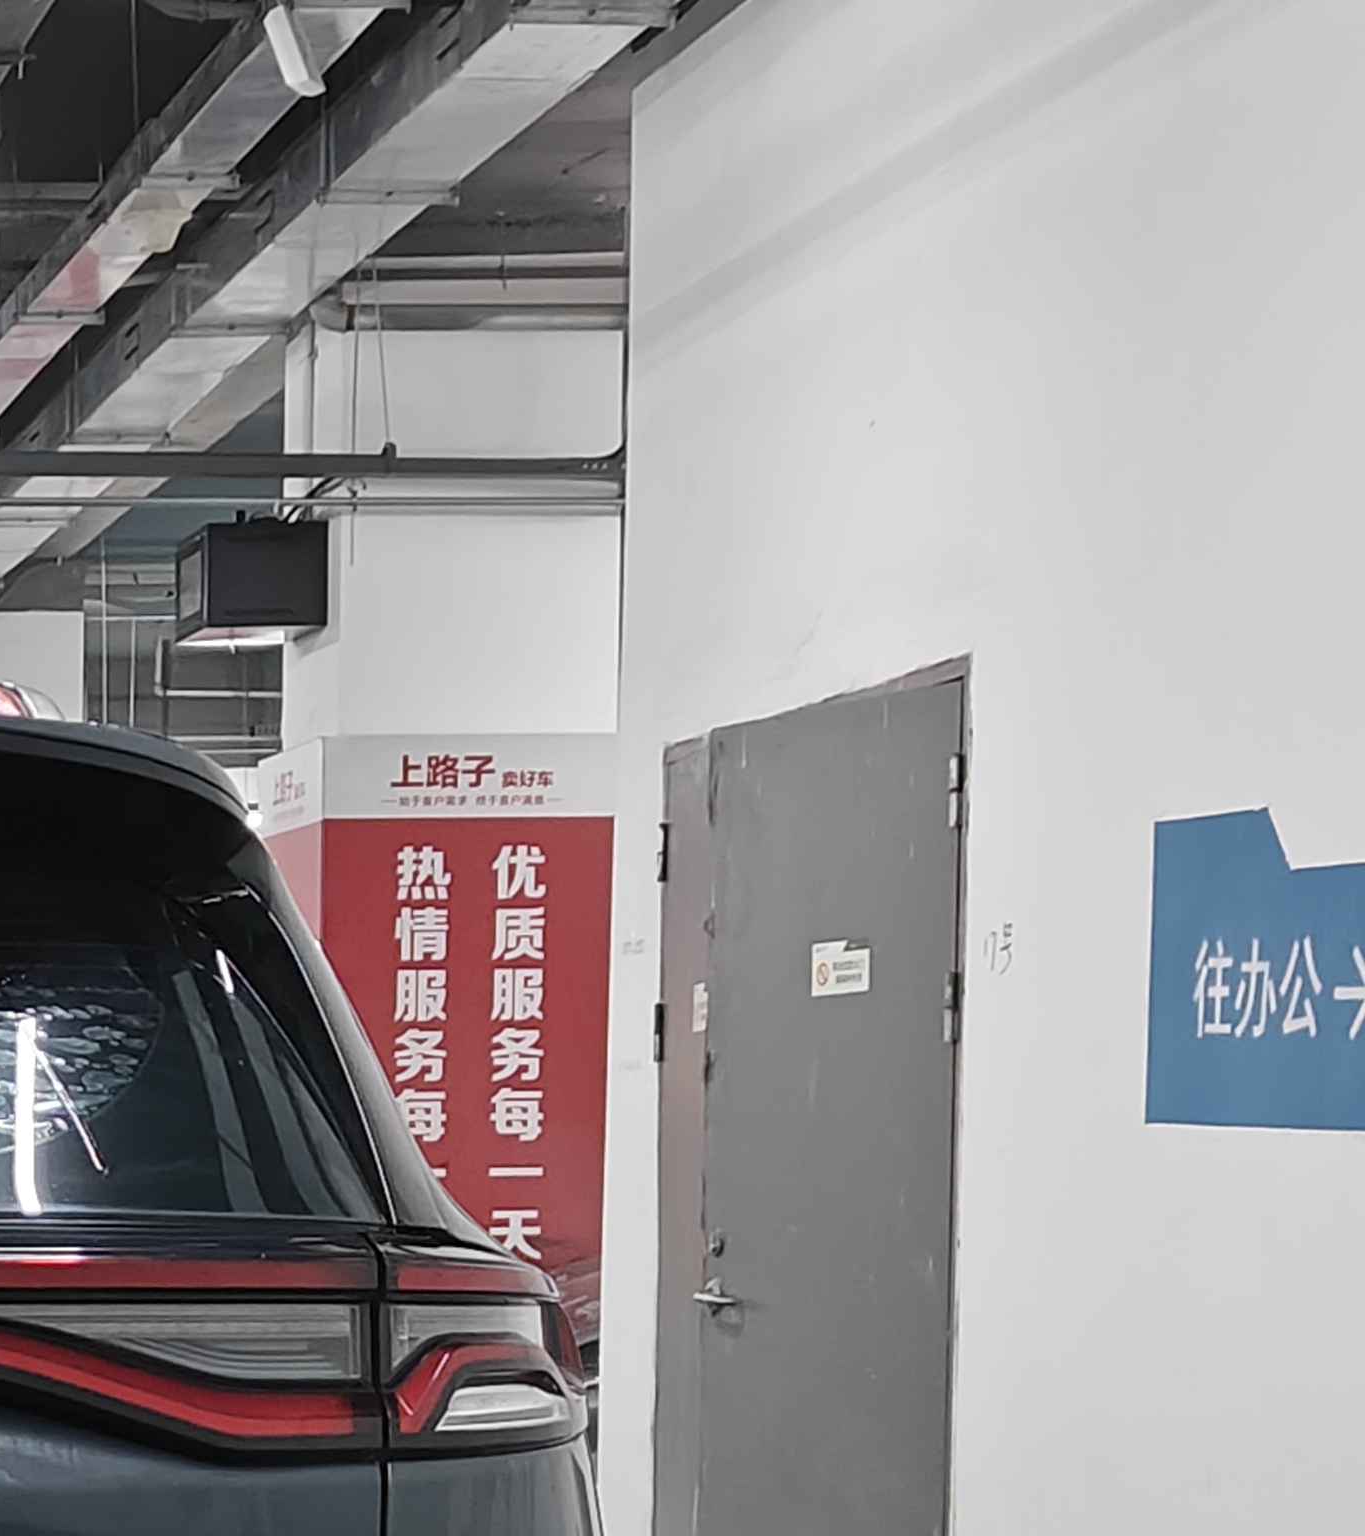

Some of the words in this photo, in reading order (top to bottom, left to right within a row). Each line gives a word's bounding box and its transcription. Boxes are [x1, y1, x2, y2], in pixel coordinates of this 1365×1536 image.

[390, 754, 496, 788] 上路子
[502, 770, 554, 788] 卖好车
[394, 846, 453, 1178] 热情服务每
[488, 844, 547, 1260] 优质服务每一天
[1193, 935, 1323, 1038] 往办公
